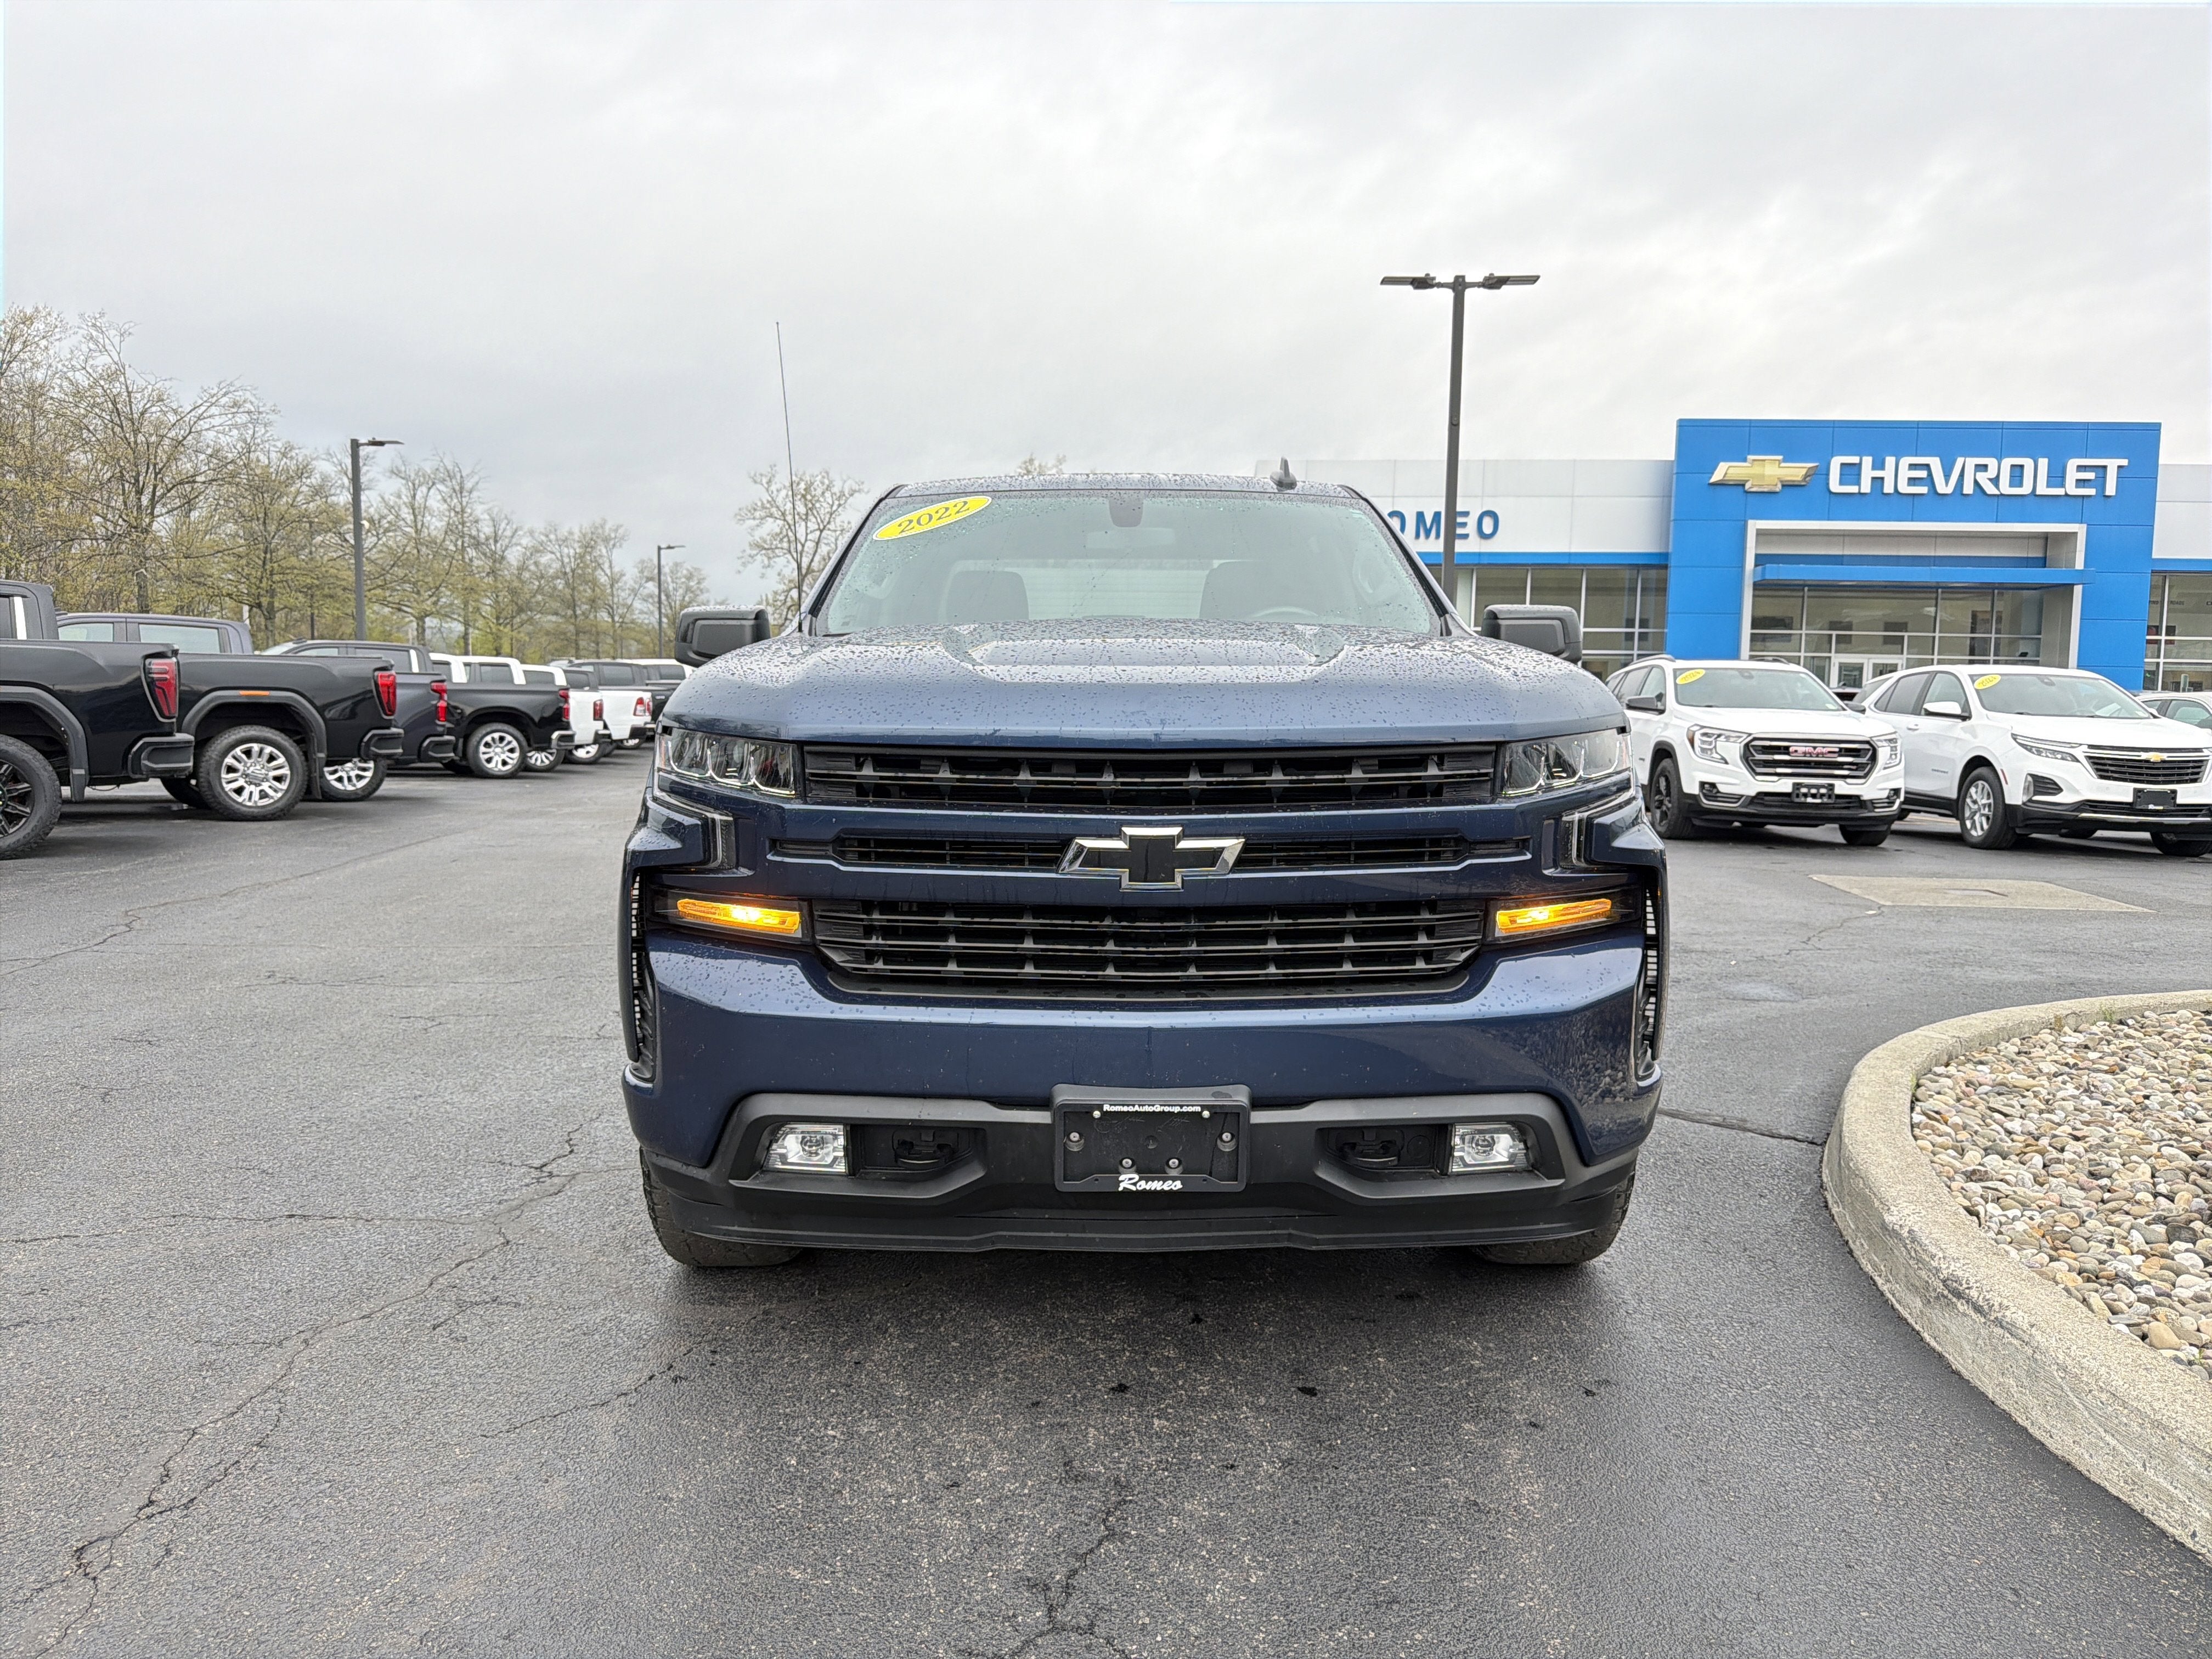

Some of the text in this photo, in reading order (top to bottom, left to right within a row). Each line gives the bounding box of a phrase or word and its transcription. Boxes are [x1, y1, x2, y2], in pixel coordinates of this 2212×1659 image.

[1829, 456, 2129, 496] CHEVROLET
[897, 500, 970, 534] 2022
[1387, 510, 1499, 540] OMEO
[1790, 746, 1839, 758] GMC
[1103, 1104, 1201, 1113] RomeoAutoGroup.com
[1118, 1173, 1183, 1192] Romeo
